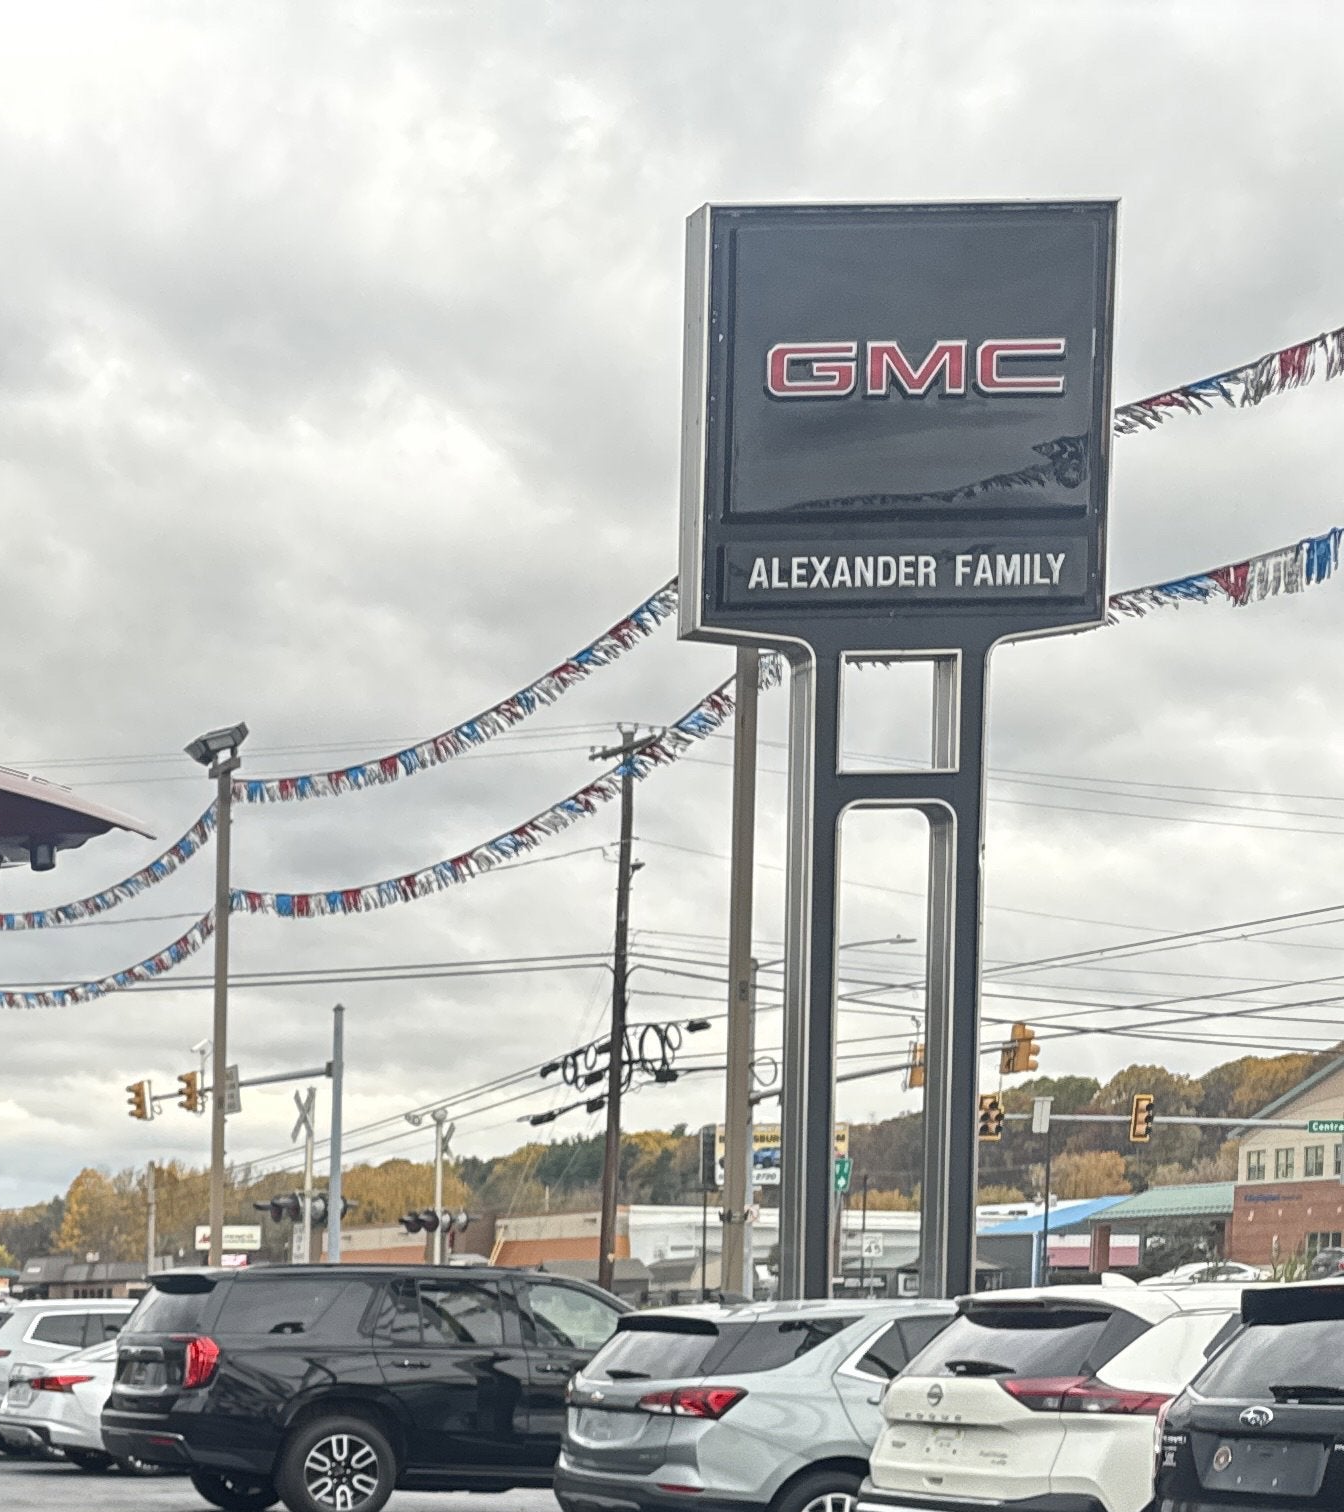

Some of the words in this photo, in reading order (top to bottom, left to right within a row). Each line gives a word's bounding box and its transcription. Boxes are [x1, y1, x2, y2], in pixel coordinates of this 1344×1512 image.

[766, 338, 1066, 396] GMC
[747, 556, 937, 589] ALEXANDER
[954, 552, 1066, 586] FAMILY
